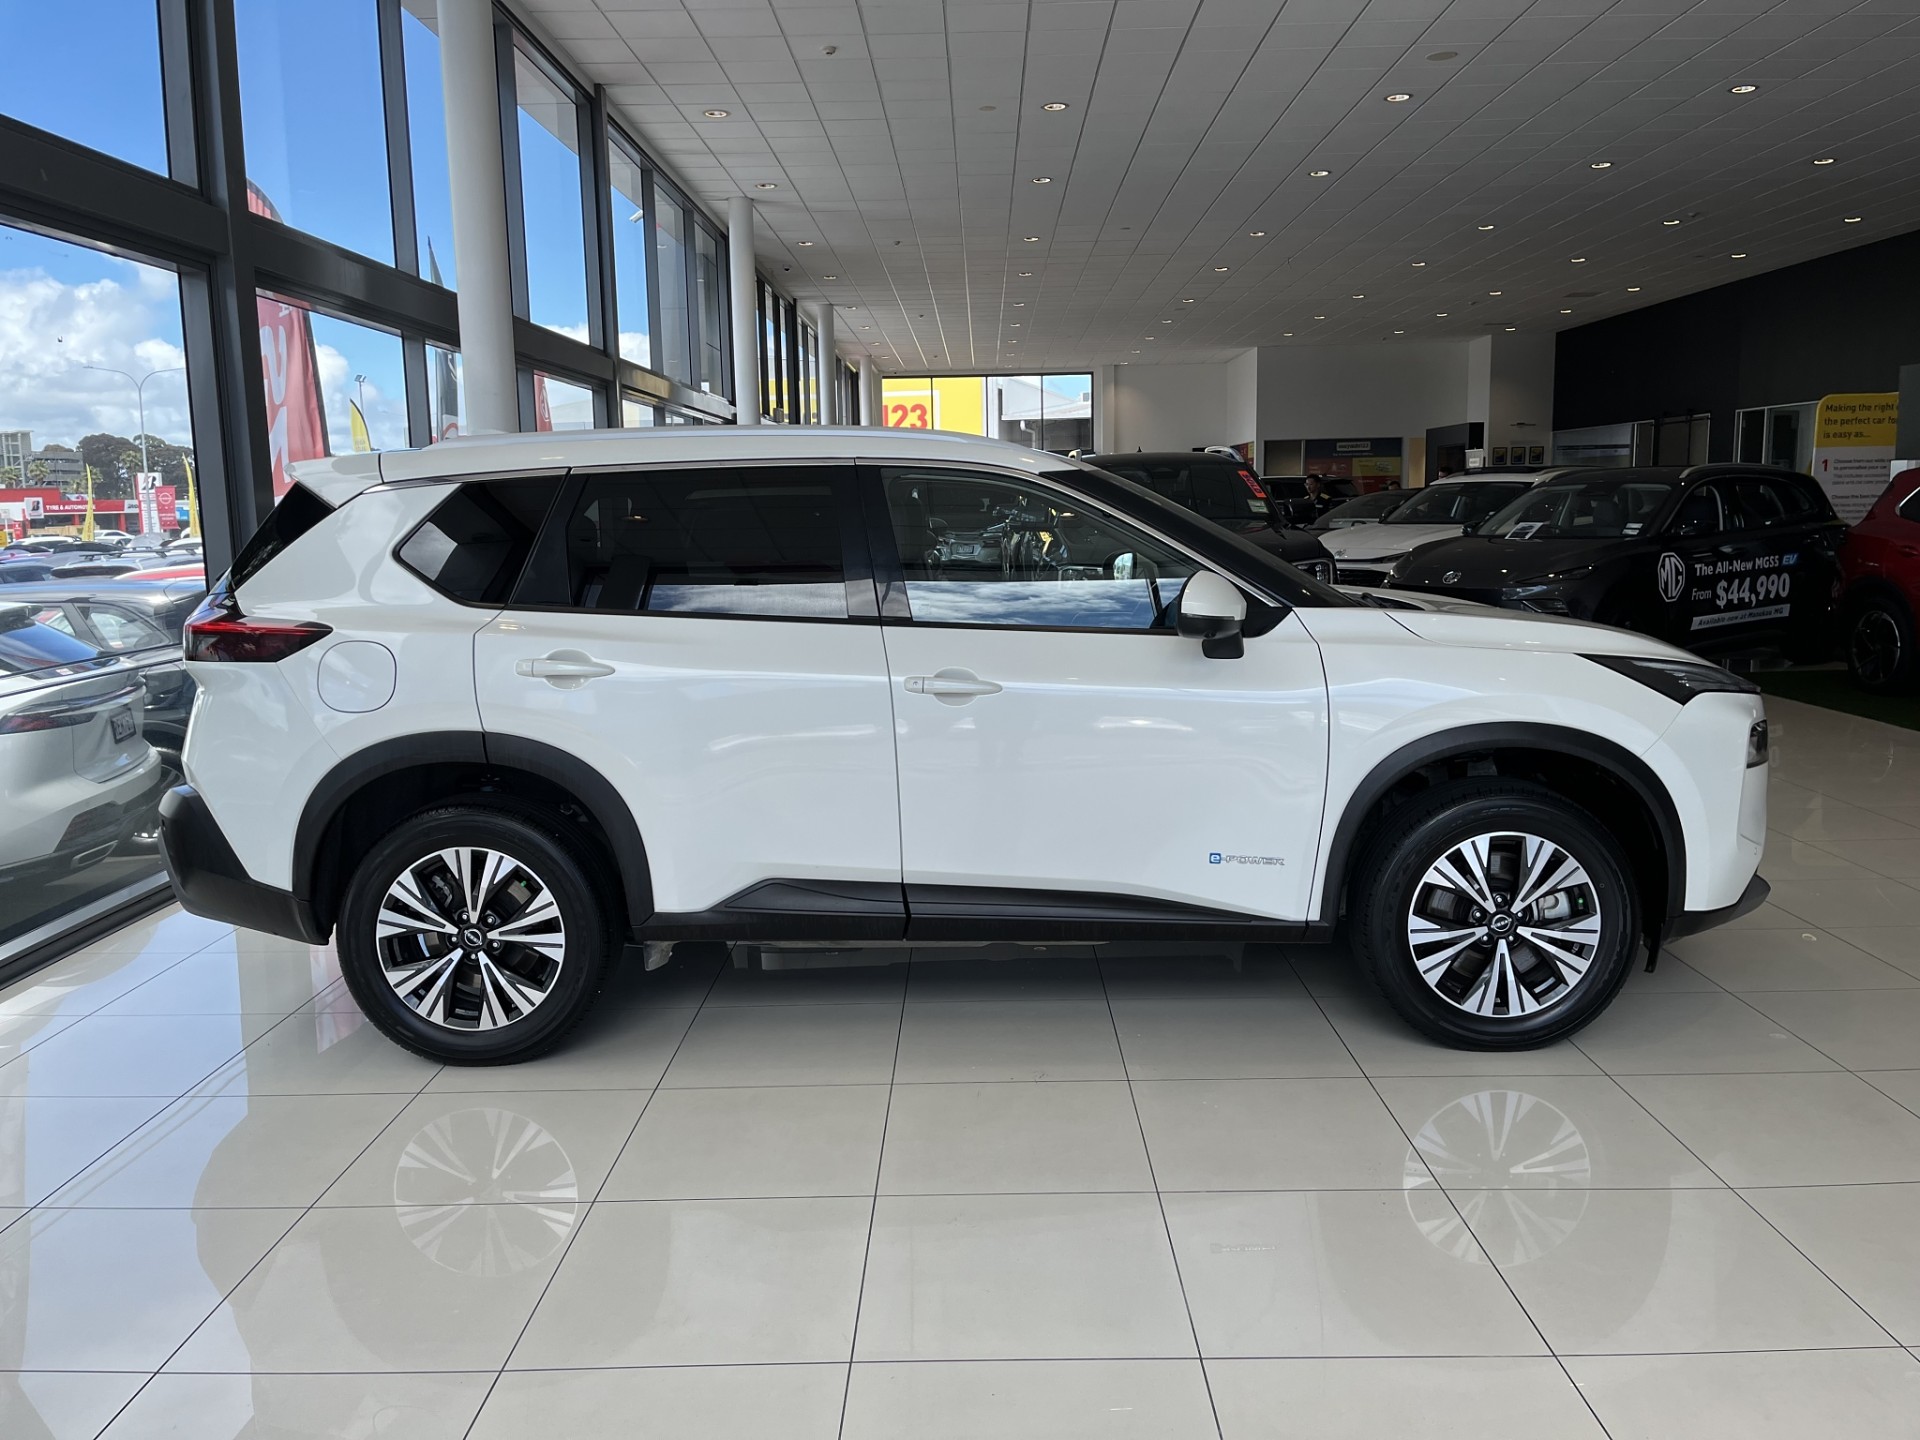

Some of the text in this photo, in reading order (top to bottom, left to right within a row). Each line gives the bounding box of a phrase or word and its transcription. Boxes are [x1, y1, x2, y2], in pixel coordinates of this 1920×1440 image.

[1825, 403, 1895, 413] Making the right
[1824, 417, 1838, 425] the
[1840, 416, 1870, 426] perfect
[1872, 416, 1886, 425] car
[1823, 431, 1831, 439] is
[1832, 431, 1852, 439] easy
[1822, 459, 1828, 472] 1
[1695, 564, 1714, 576] The
[1715, 560, 1753, 573] All-New
[1781, 553, 1799, 566] EV
[1691, 572, 1791, 609] From $44,990
